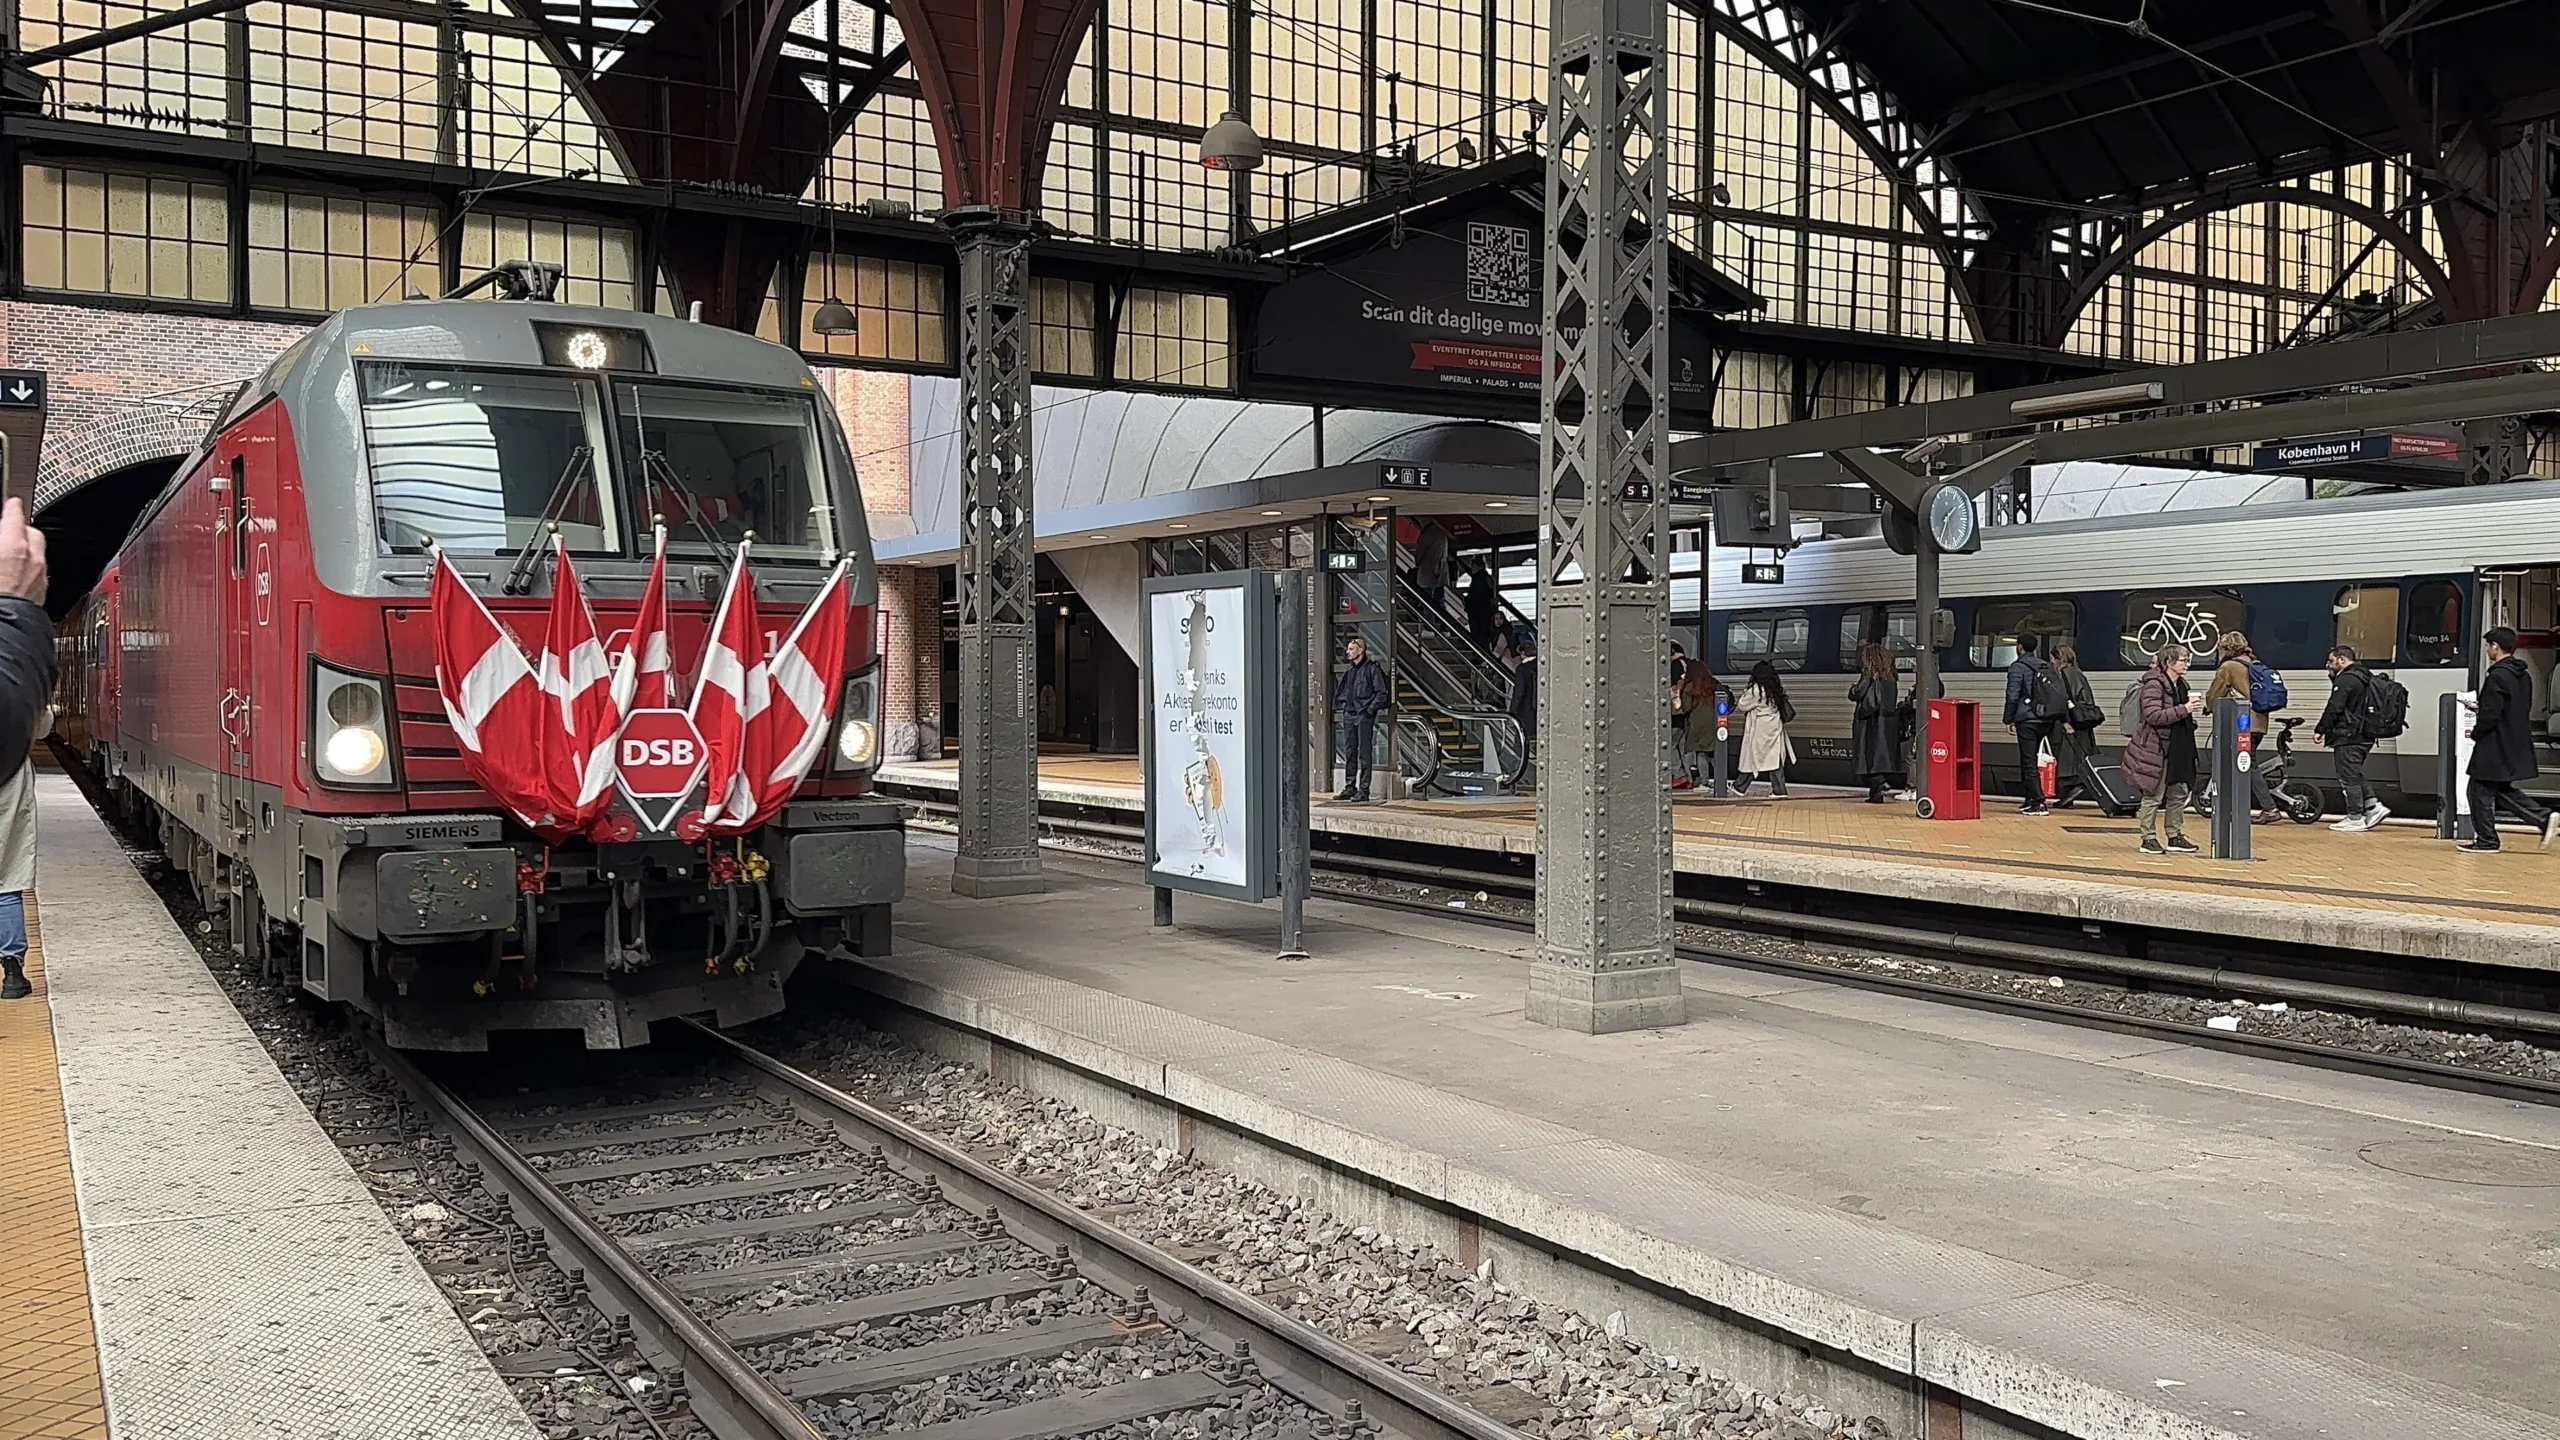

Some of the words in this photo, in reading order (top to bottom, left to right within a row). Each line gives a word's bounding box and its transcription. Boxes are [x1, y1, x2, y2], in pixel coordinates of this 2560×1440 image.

[1362, 300, 1404, 322] Scan
[1409, 305, 1434, 325] dit
[1437, 308, 1504, 336] daglige
[1508, 319, 1545, 337] mov
[1432, 345, 1470, 355] EVENTYRET
[1471, 349, 1514, 360] FORTSÆTTER
[1519, 353, 1543, 361] BIOGRA
[1468, 358, 1479, 366] OG
[1480, 358, 1489, 367] PÅ
[1440, 374, 1472, 384] IMPERIAL
[1482, 378, 1509, 387] PALADS
[1518, 381, 1543, 390] DAGMA
[2278, 444, 2347, 460] København
[2350, 440, 2361, 453] H
[1420, 472, 1428, 485] E
[1627, 486, 1635, 496] S
[1876, 499, 1882, 509] E
[257, 571, 269, 596] DSB
[1180, 615, 1215, 634] SO
[2418, 635, 2438, 644] Vogn
[2440, 634, 2450, 642] 14
[1175, 668, 1226, 686] Saanks
[1163, 692, 1238, 711] Aktiesrekonto
[1169, 719, 1183, 732] er
[1214, 719, 1233, 735] test
[622, 739, 694, 766] DSB
[1932, 748, 1946, 756] DSB
[813, 811, 860, 822] Vectron
[405, 825, 480, 840] SIEMENS
